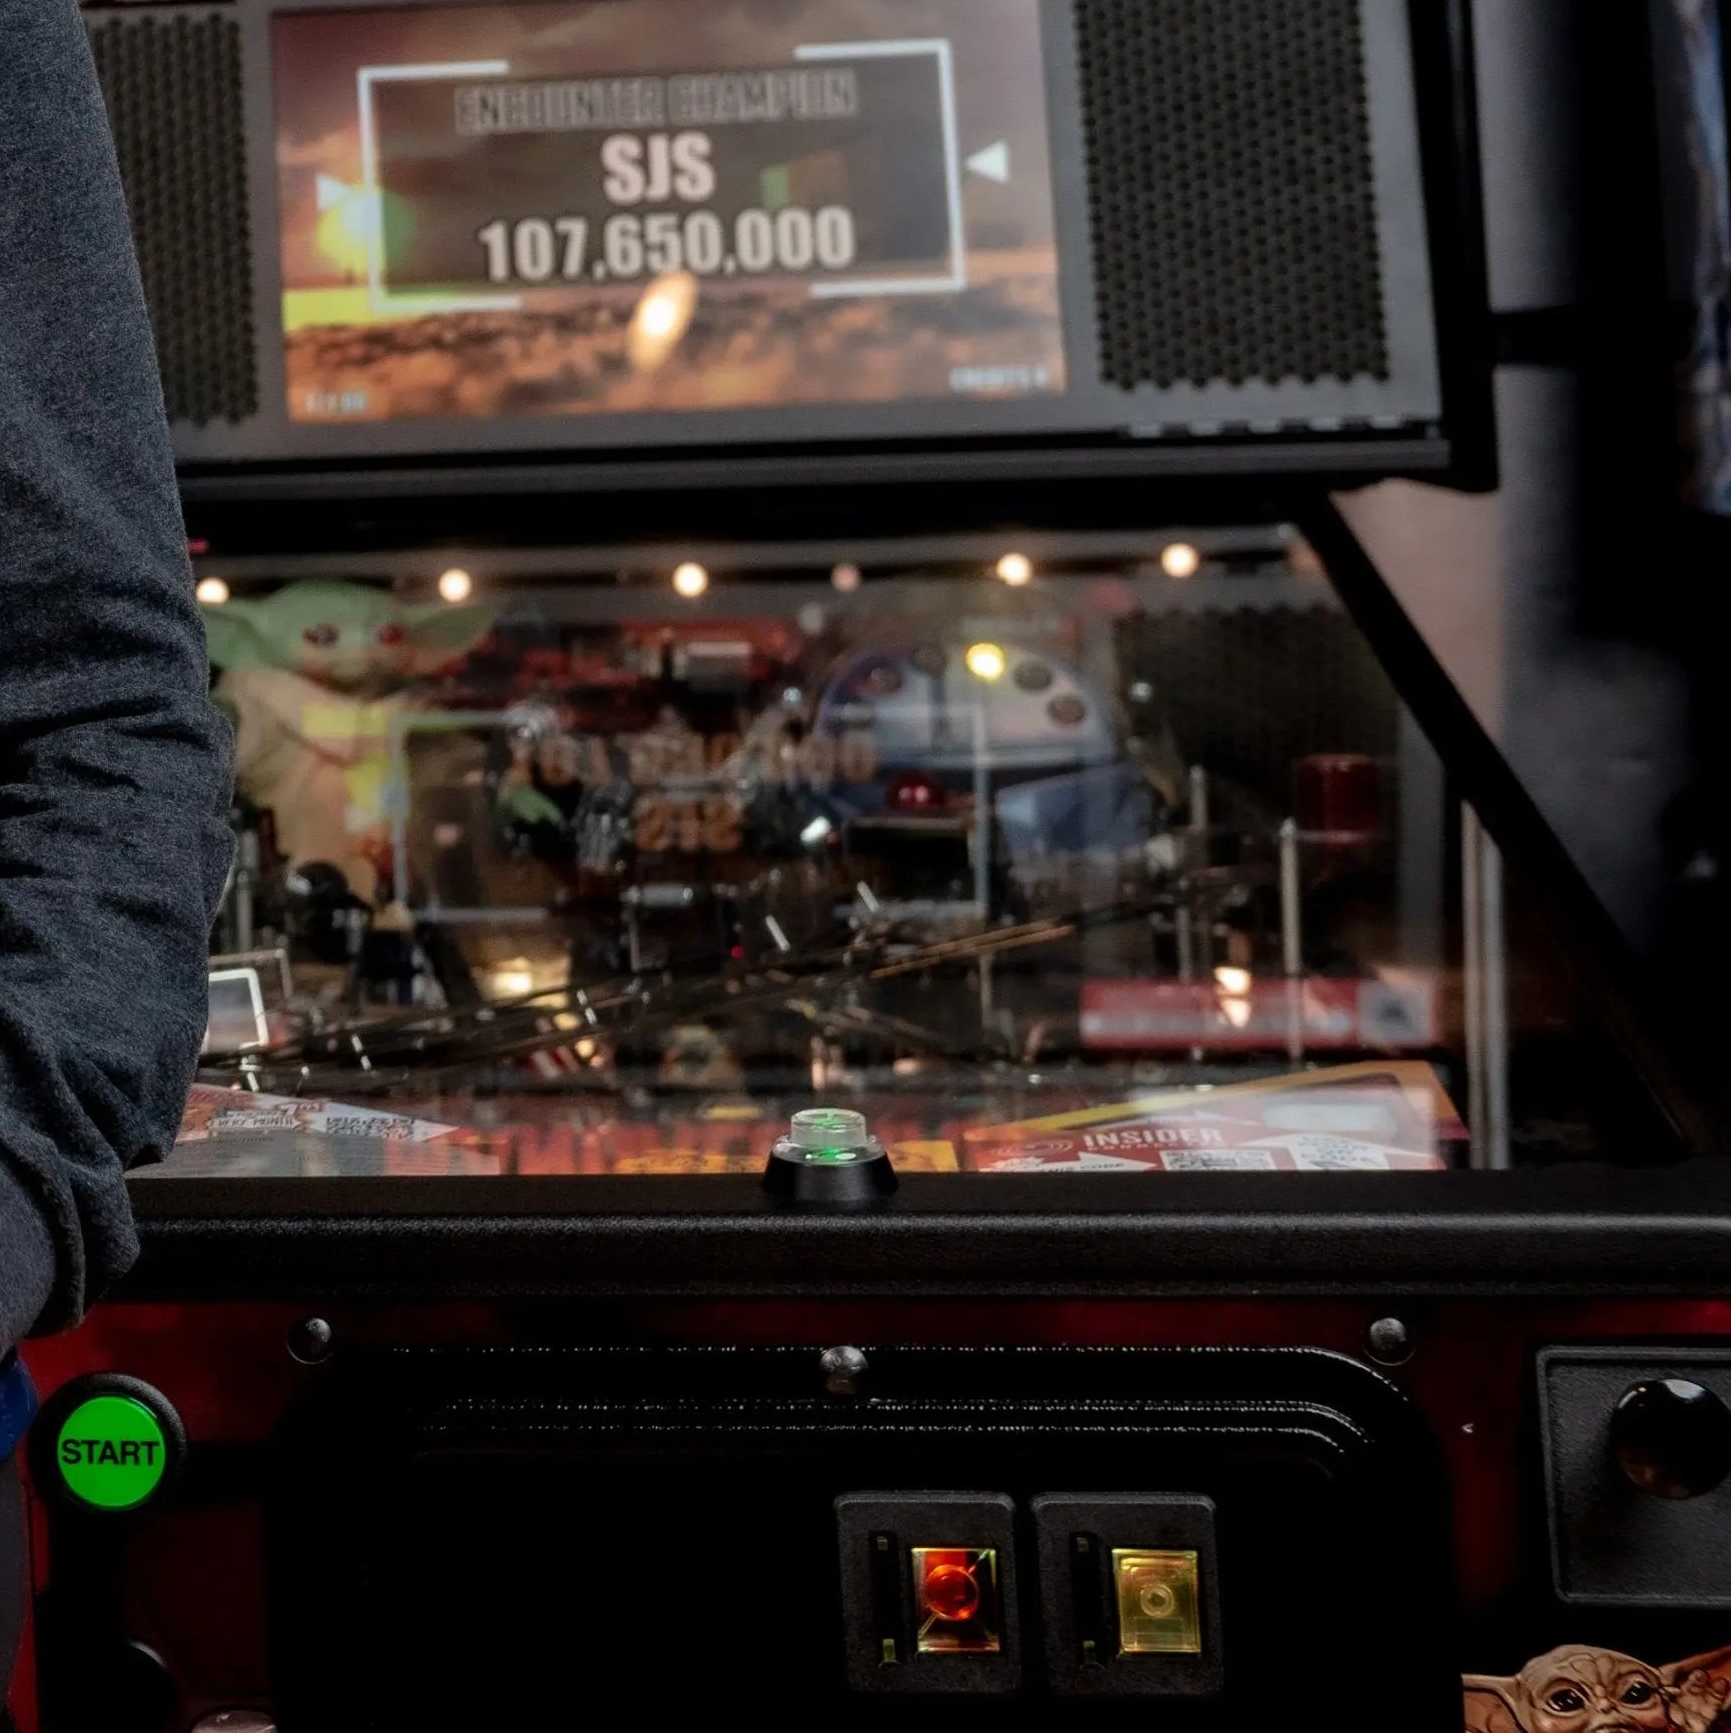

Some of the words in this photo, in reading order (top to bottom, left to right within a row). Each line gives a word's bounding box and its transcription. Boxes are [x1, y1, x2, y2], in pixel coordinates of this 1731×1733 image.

[602, 131, 715, 204] SJS
[479, 205, 856, 283] 107,650,000
[1083, 1129, 1223, 1147] INSIDER
[61, 1439, 160, 1466] START
